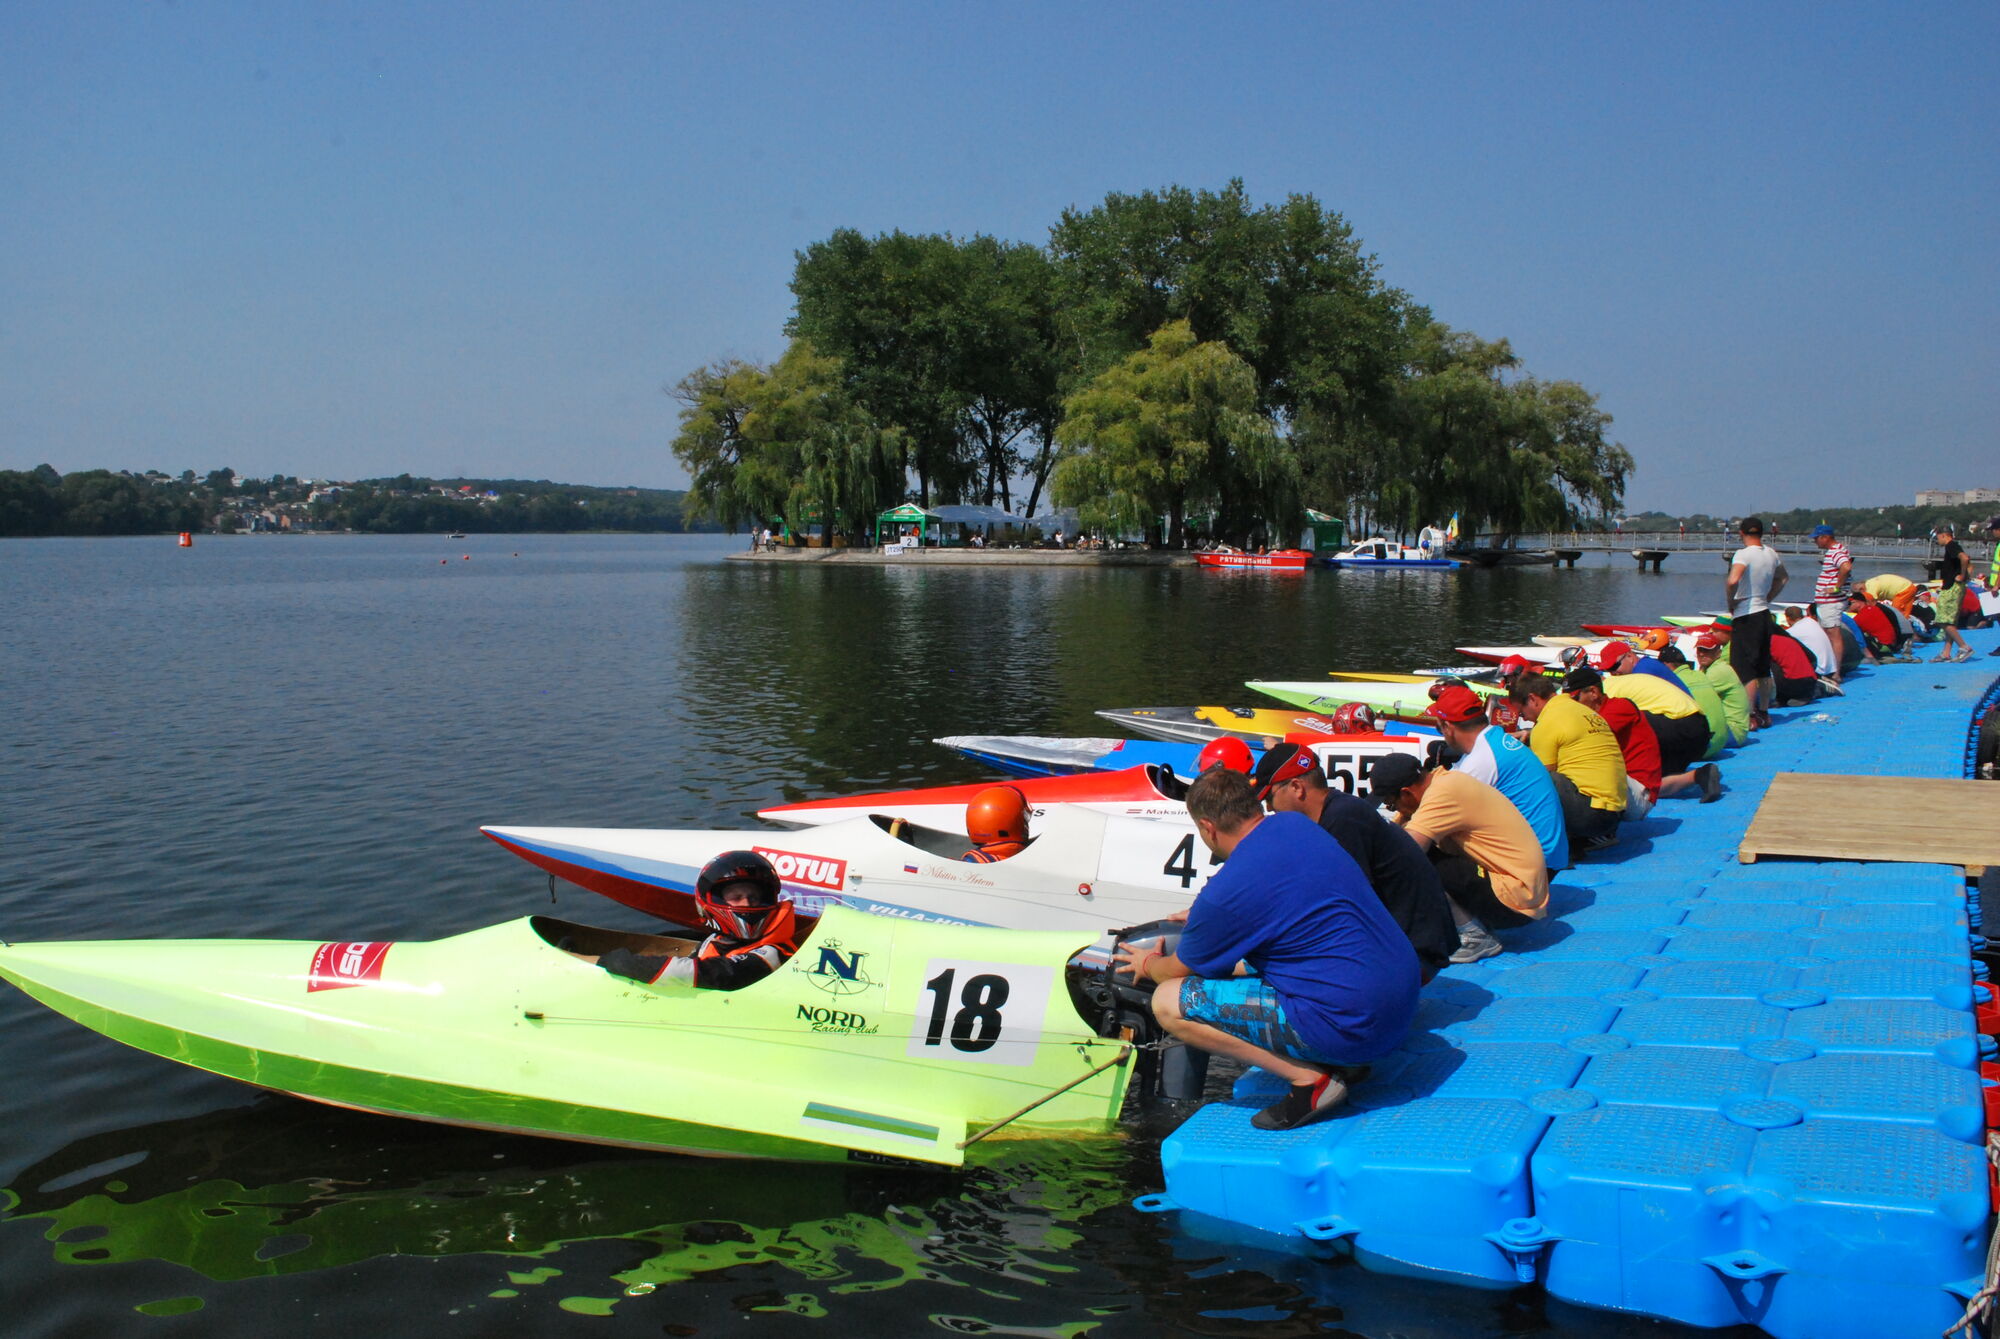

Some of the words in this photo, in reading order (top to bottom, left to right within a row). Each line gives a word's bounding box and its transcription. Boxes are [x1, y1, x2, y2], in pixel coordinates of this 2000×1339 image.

[907, 538, 912, 547] 2
[796, 1003, 866, 1029] NORD
[925, 968, 1010, 1053] 18
[811, 1021, 851, 1037] Racing
[855, 1024, 879, 1035] club
